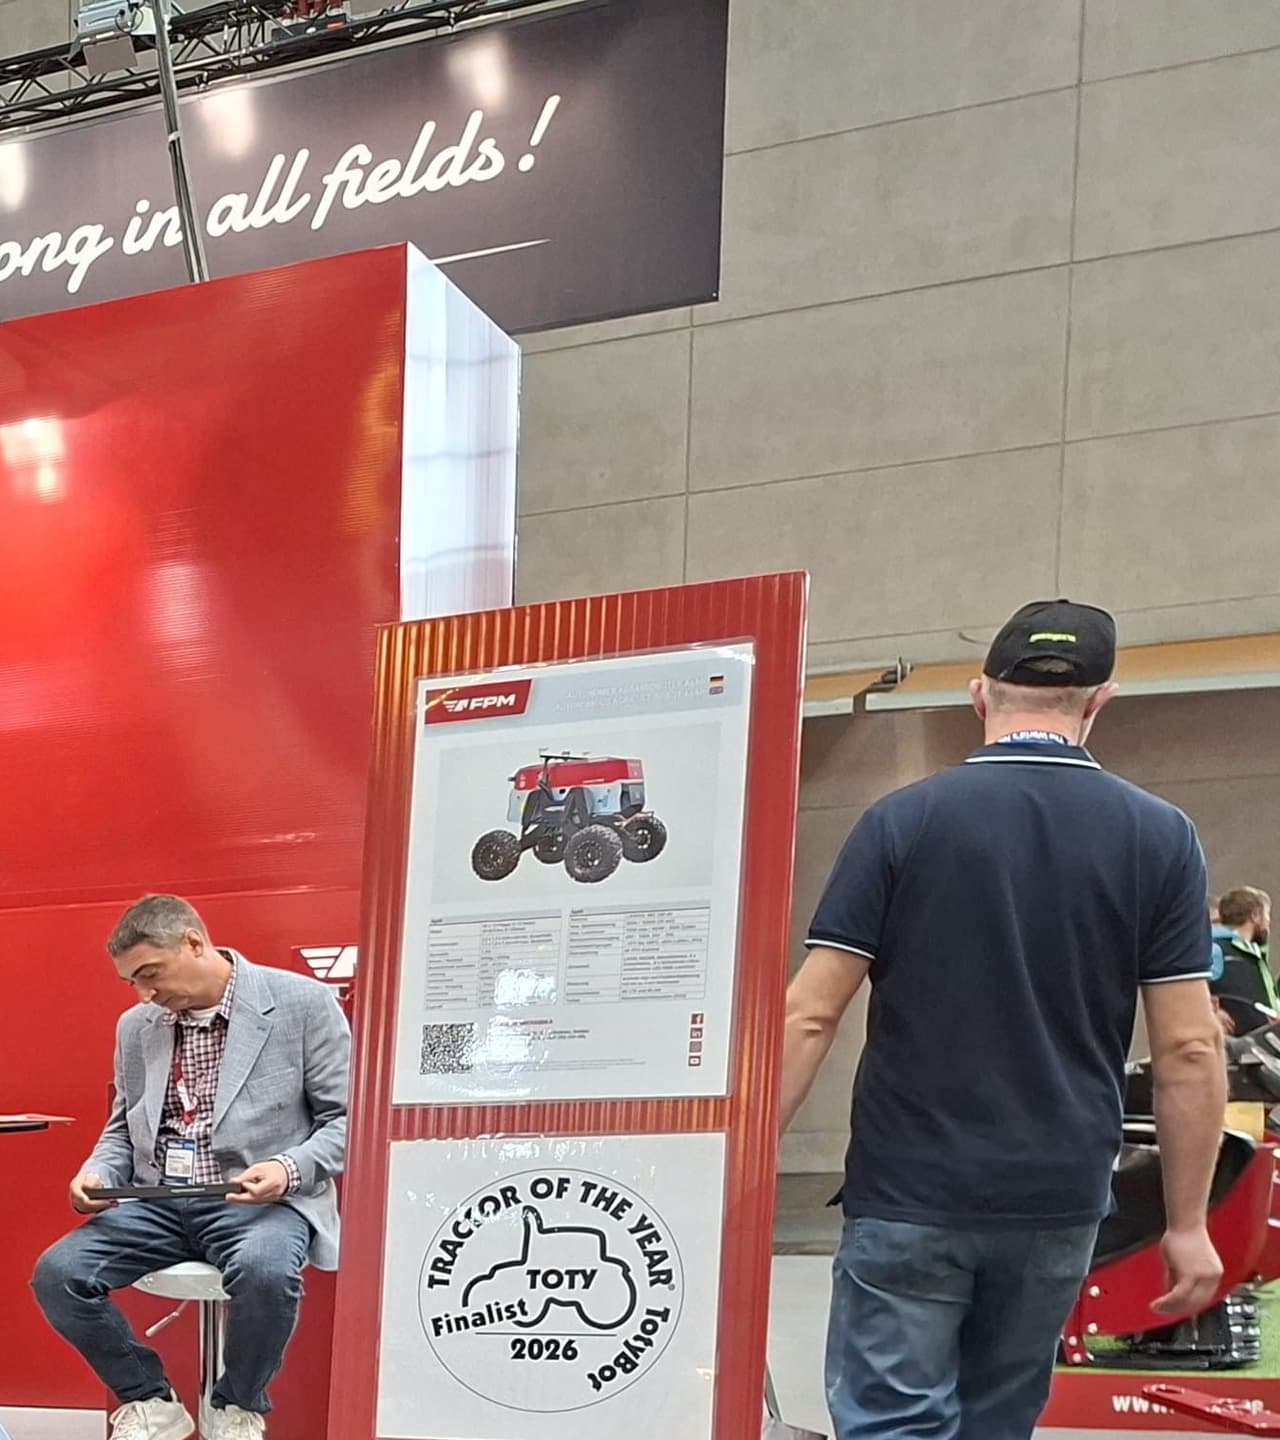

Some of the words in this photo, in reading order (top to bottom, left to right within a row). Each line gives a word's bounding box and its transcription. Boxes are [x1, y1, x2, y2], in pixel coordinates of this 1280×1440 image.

[121, 199, 186, 253] in
[205, 147, 312, 237] all
[468, 693, 517, 711] FPM
[530, 1177, 571, 1200] OF
[580, 1180, 633, 1221] THE
[526, 1268, 598, 1290] TOTY
[431, 1298, 529, 1337] Finalist
[510, 1338, 579, 1361] 2026
[586, 1306, 671, 1392] TotyBot
